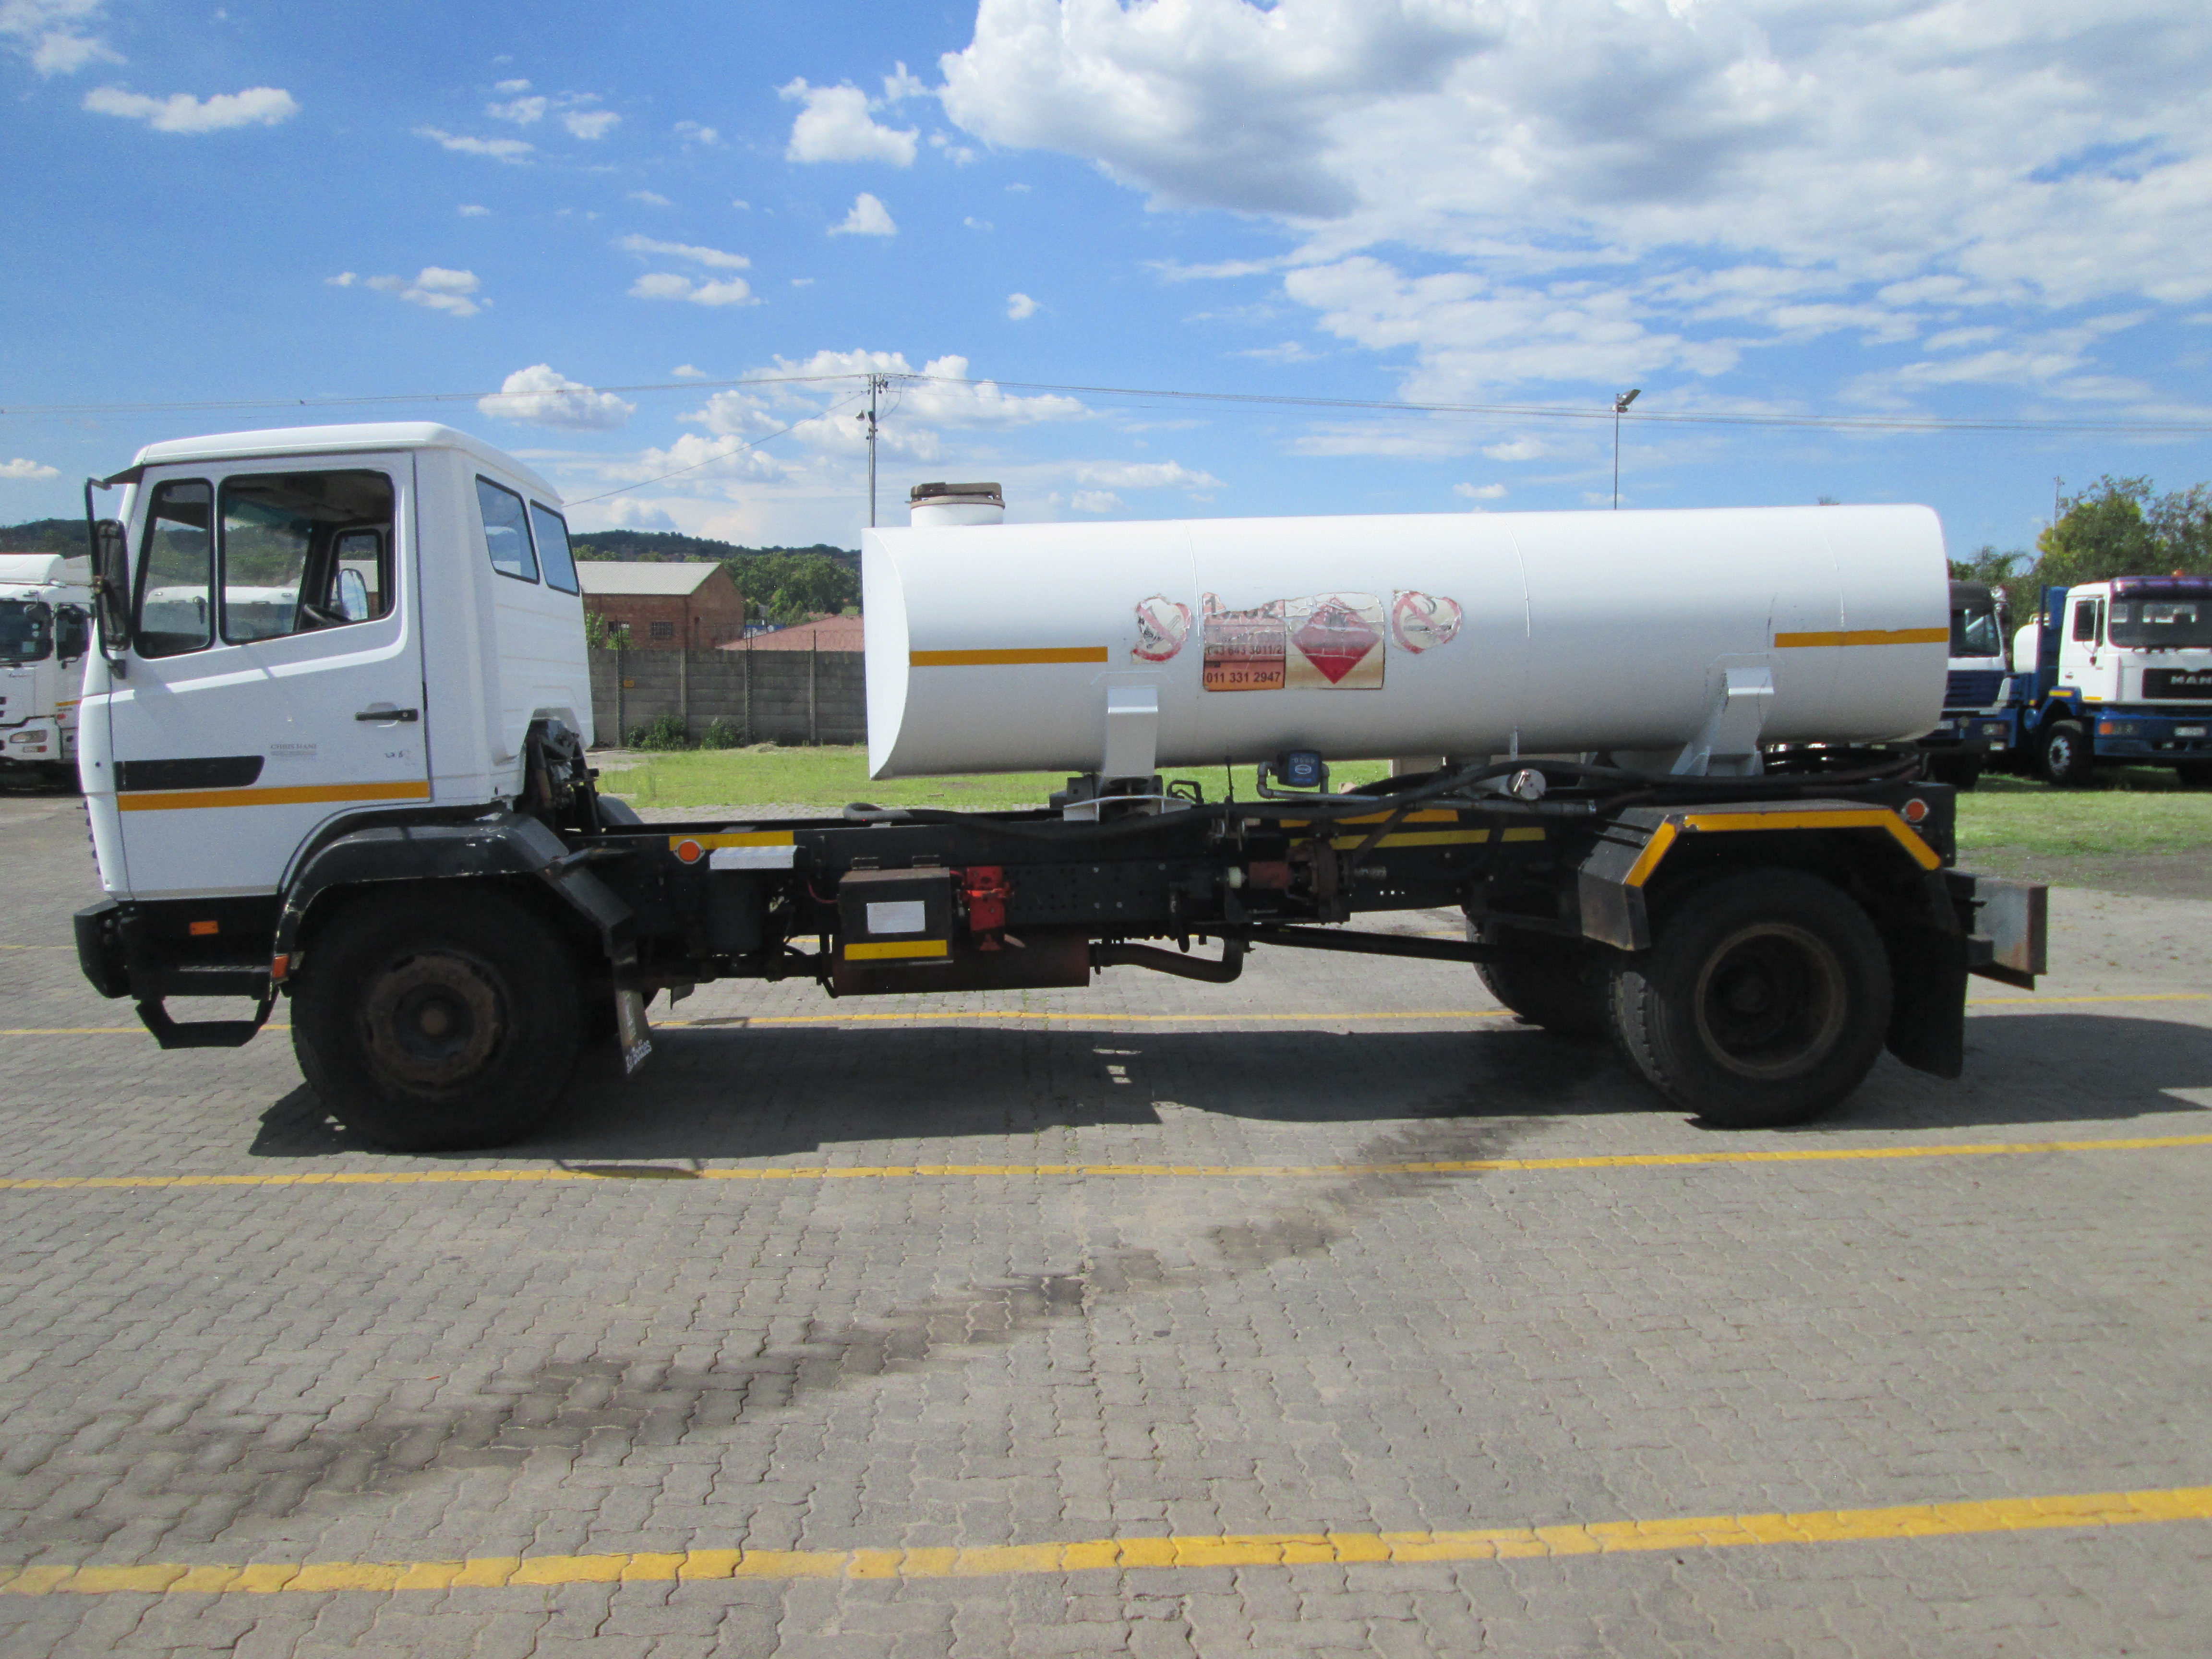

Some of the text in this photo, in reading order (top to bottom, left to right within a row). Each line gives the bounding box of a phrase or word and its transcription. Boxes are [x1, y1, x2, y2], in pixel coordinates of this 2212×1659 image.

[1228, 645, 1246, 655] 643
[1249, 644, 1282, 655] 3011/2
[1206, 672, 1281, 683] 011 331 2947
[2170, 676, 2212, 684] MAN
